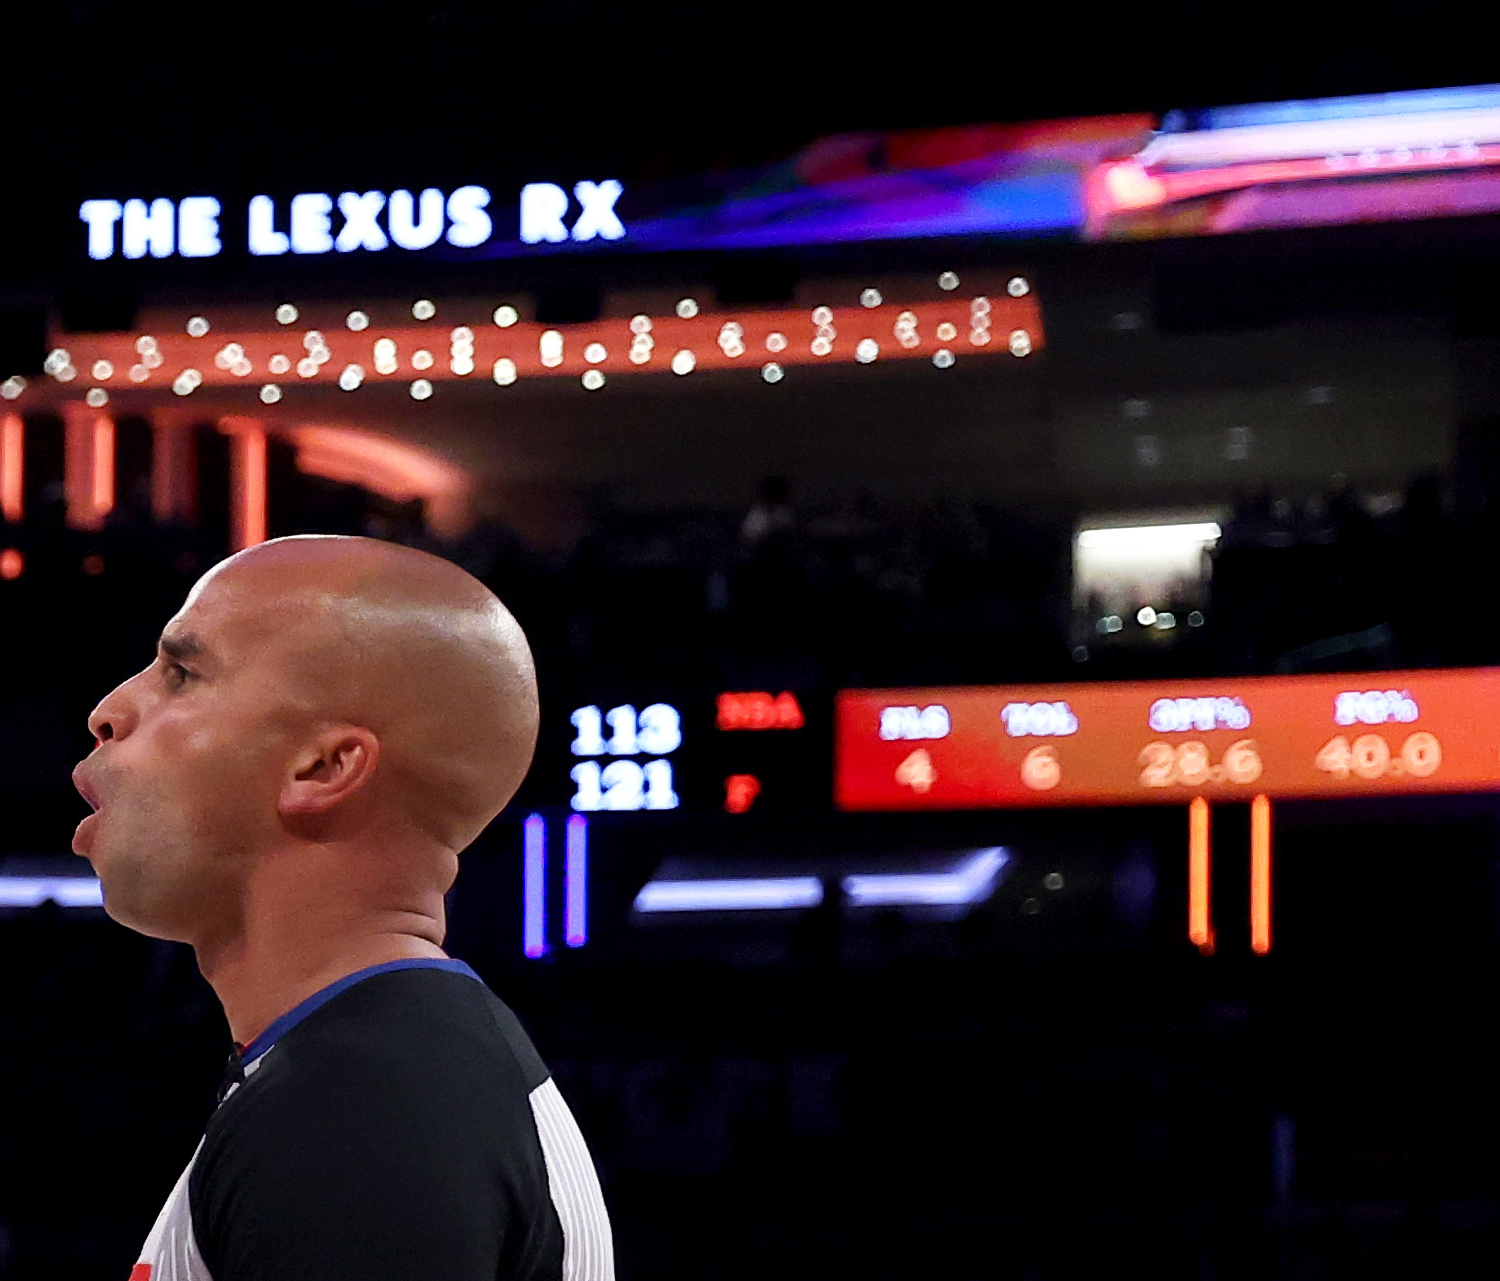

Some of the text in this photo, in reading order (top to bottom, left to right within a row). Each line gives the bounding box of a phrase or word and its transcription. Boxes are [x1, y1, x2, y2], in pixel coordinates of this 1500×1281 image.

[79, 179, 627, 260] THE LEXUS RX
[570, 759, 680, 811] 121
[895, 731, 1442, 794] 4 6 28.6 40.0
